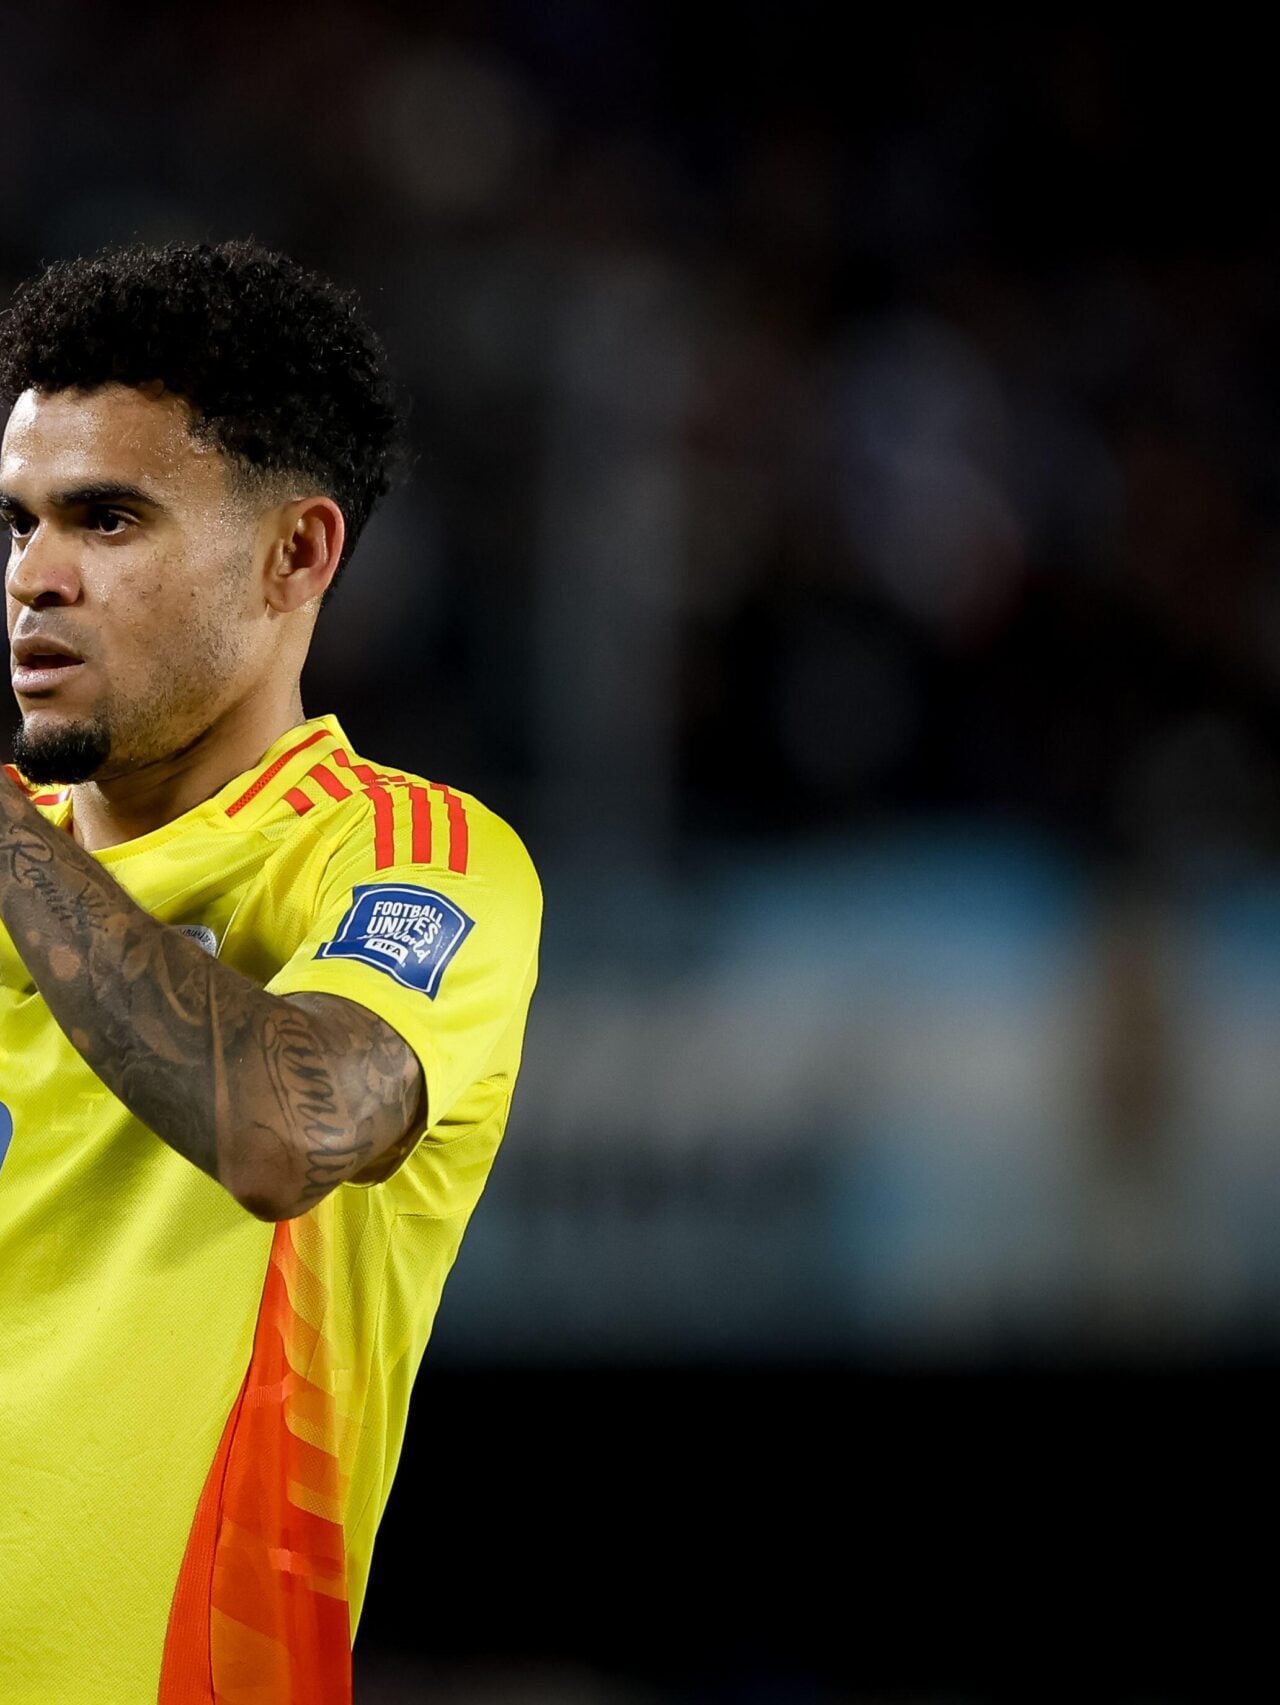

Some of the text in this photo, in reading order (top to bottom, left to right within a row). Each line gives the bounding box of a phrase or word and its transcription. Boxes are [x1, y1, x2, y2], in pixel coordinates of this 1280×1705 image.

[372, 901, 443, 928] FOOTBALL
[366, 916, 438, 945] UNITES
[371, 940, 402, 956] FIFA
